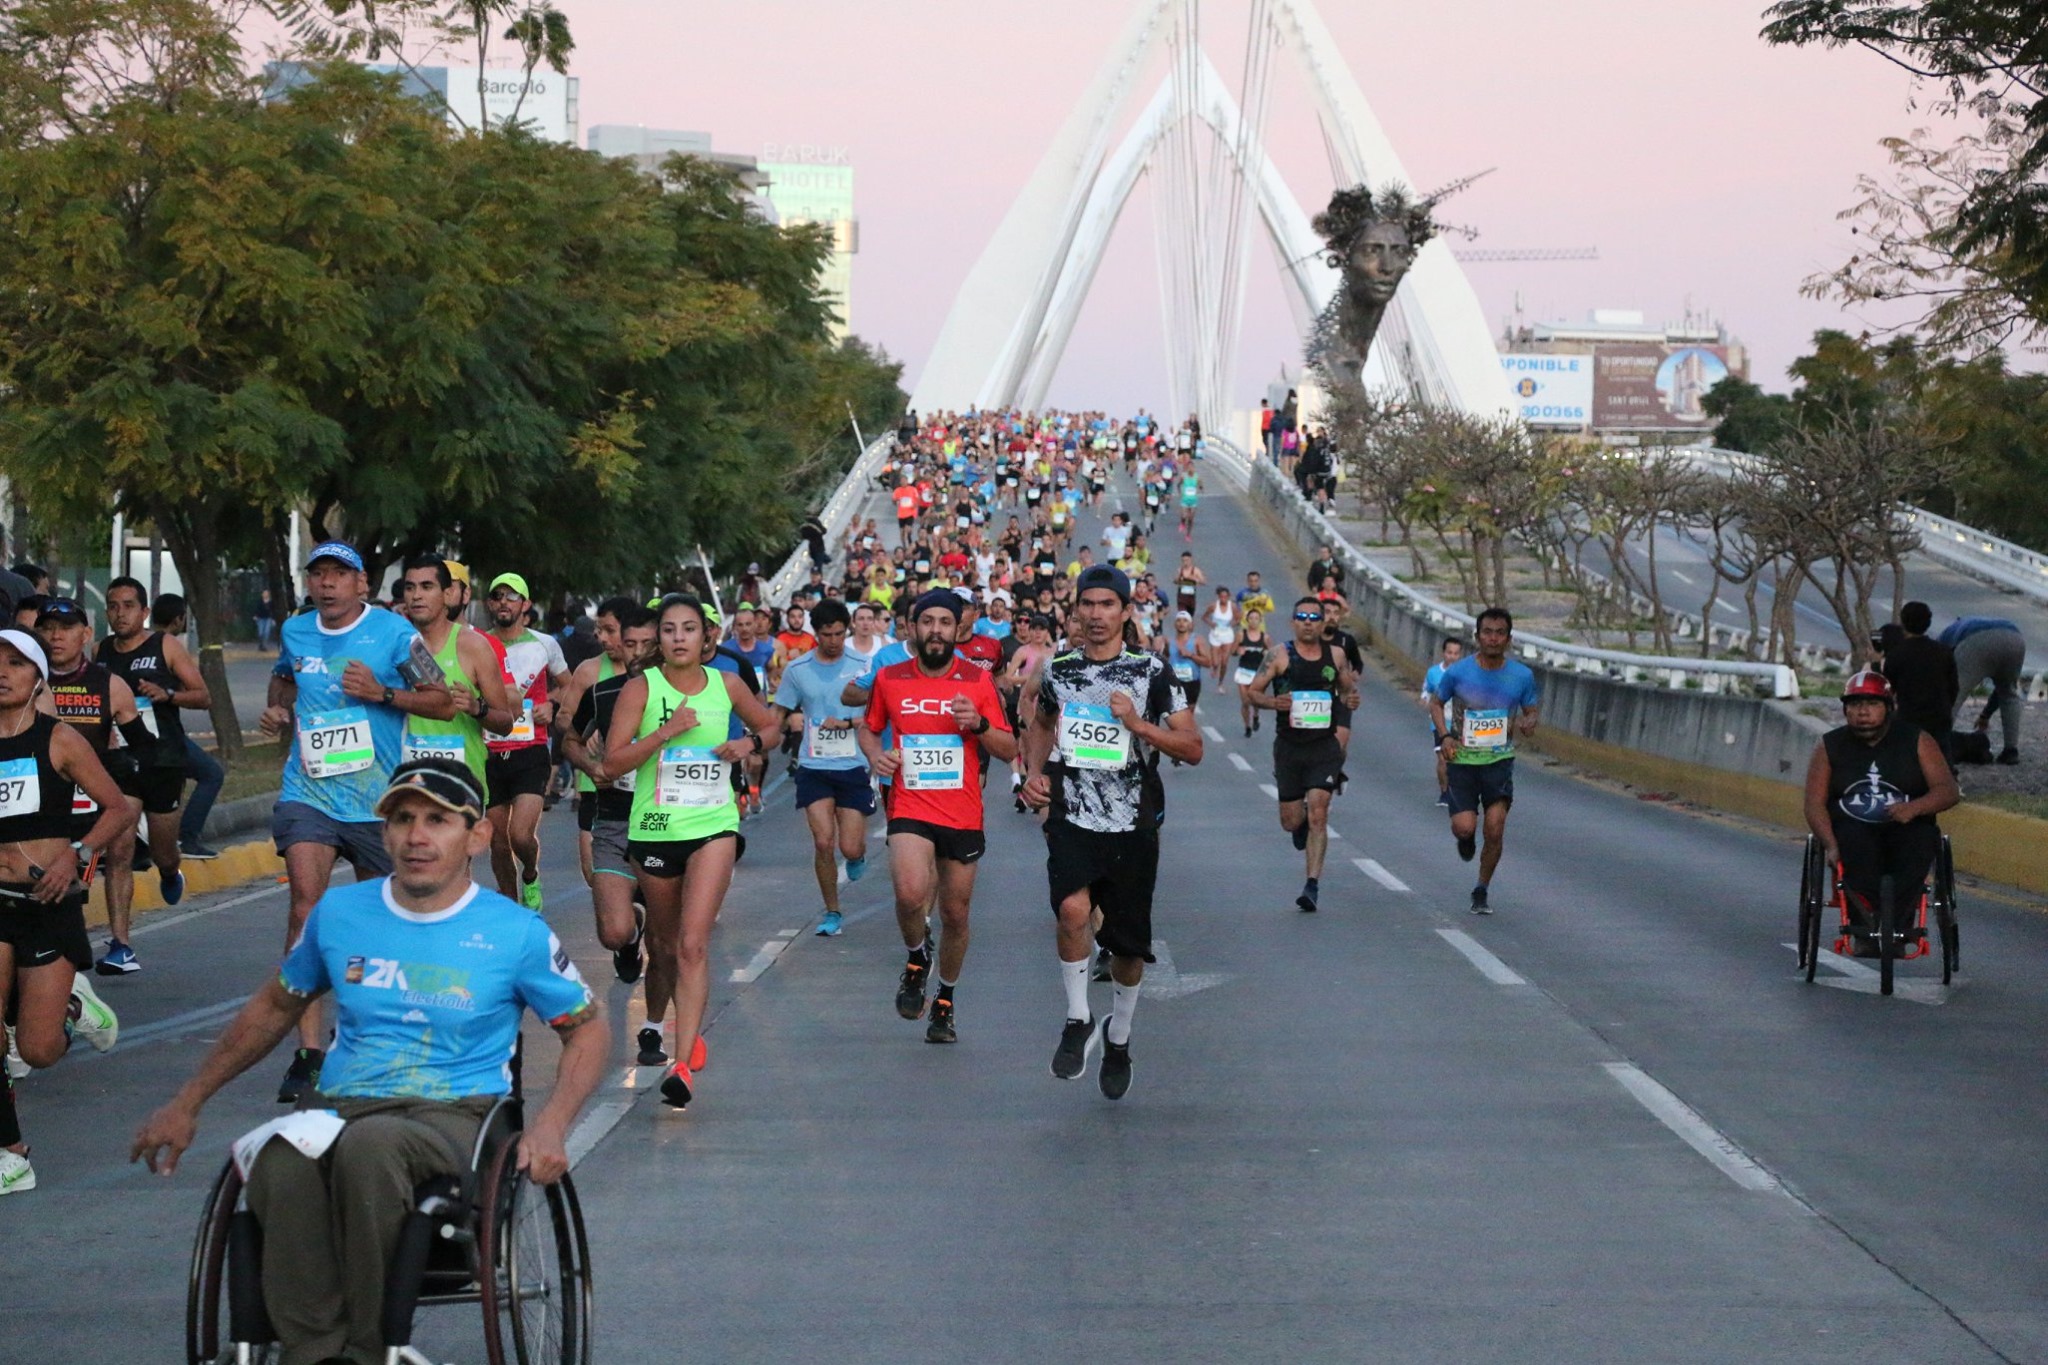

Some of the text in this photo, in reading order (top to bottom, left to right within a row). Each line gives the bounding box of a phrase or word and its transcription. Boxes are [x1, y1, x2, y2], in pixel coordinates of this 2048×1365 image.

[477, 79, 546, 94] Barceló
[763, 142, 849, 163] BARUK
[782, 171, 847, 189] HOTEL
[1500, 358, 1578, 371] PONIBLE
[52, 686, 87, 694] CARRERA
[56, 694, 101, 707] BEROS
[1303, 702, 1323, 712] 771
[60, 707, 101, 715] LAJARA
[1470, 719, 1504, 731] 12993
[311, 726, 358, 750] 8771
[818, 728, 848, 741] 5210
[1068, 722, 1120, 745] 4562
[913, 750, 953, 766] 3316
[675, 763, 720, 780] 5615
[0, 780, 26, 803] 87
[643, 812, 671, 823] SPORT
[648, 822, 668, 832] CITY
